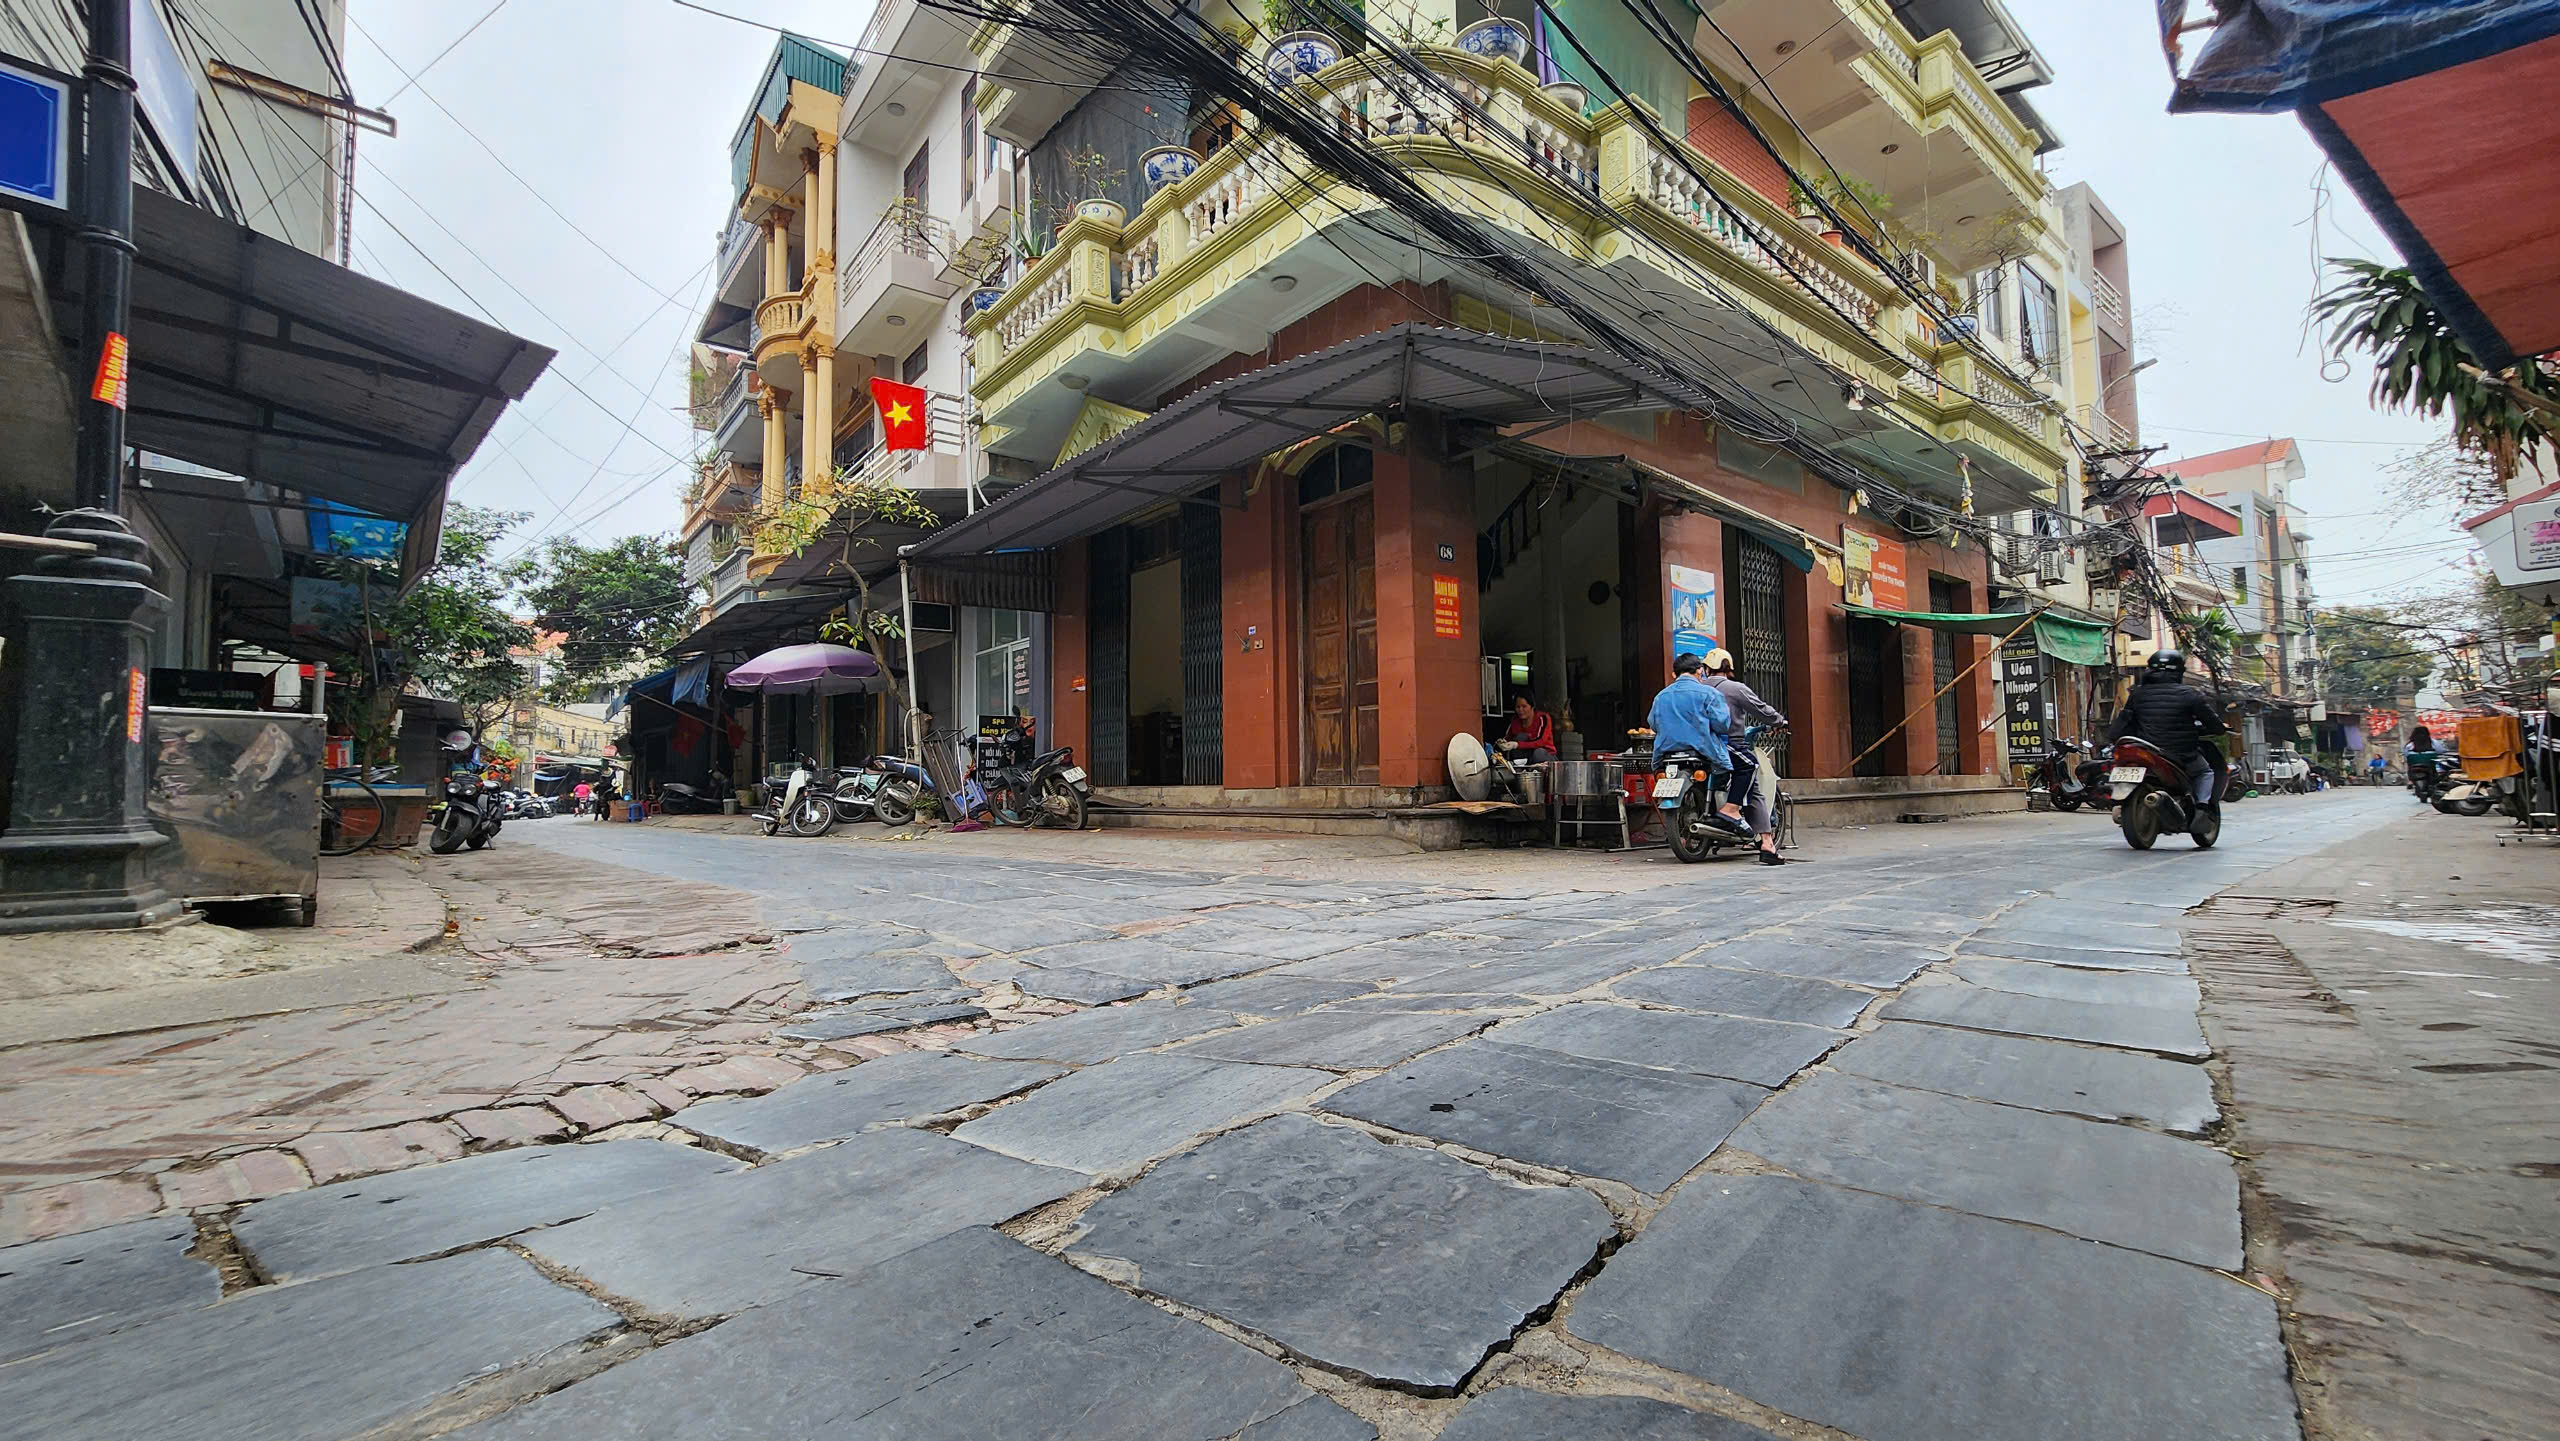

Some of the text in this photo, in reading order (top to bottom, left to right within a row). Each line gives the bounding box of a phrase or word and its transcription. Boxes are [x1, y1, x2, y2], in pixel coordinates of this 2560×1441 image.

[1440, 546, 1454, 560] 68
[2011, 661, 2033, 676] Uốn
[2005, 680, 2038, 696] Nhuộm
[2010, 734, 2041, 746] TÓC
